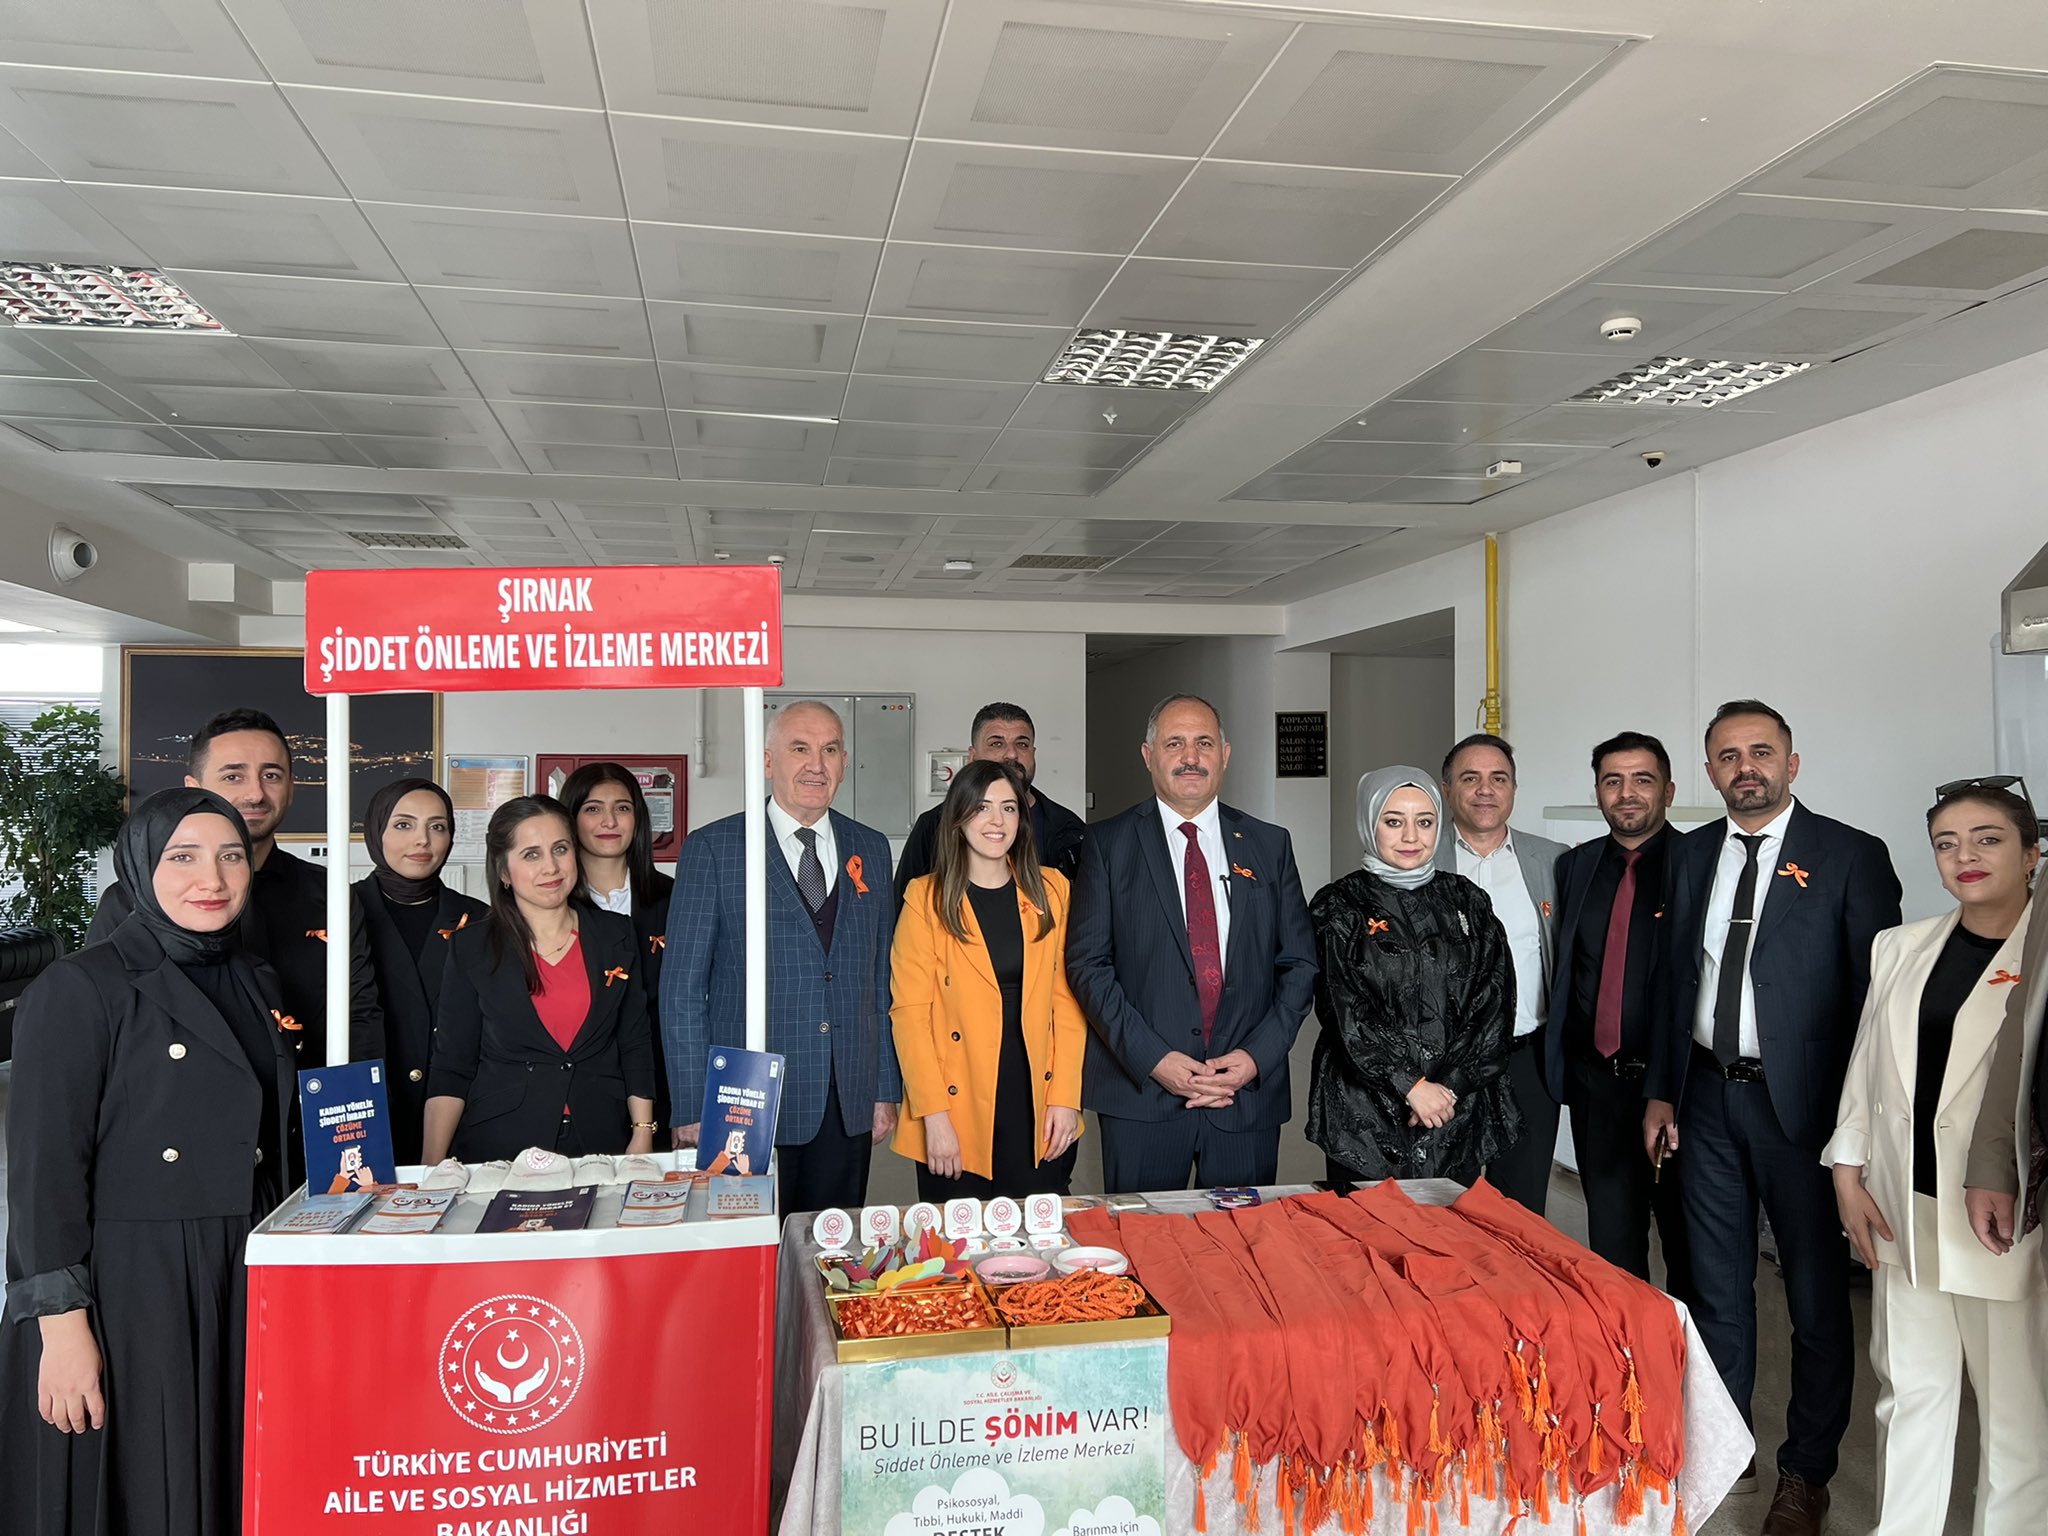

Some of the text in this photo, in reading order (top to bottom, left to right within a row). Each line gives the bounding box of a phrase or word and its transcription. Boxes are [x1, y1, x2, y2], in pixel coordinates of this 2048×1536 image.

[498, 577, 593, 623] ŞIRNAK
[320, 621, 768, 683] ŞİDDET ÖNLEME VE İZLEME MERKEZİ
[1281, 716, 1321, 724] TOPLANTI
[719, 1085, 741, 1096] KADINA
[319, 1099, 373, 1117] KADINA YÖNELİK
[319, 1114, 346, 1128] ŞİDDETİ
[367, 1108, 375, 1118] ET
[336, 1121, 362, 1134] ÇÖZÜME
[333, 1130, 367, 1143] ORTAK OL!
[860, 1406, 1148, 1450] BU İLDE ŞÖNİM VAR!
[353, 1431, 667, 1477] TÜRKİYE CUMHURİYETİ
[874, 1439, 1135, 1478] Şiddet Önleme ve İzleme Merkezi
[324, 1466, 697, 1514] AİLE VE SOSYAL HİZMETLER
[937, 1495, 1000, 1510] Psikososyal,
[437, 1509, 588, 1536] BAKANLIĞI
[914, 1508, 1023, 1527] Tıbbi, Hukuki, Maddi
[1073, 1521, 1139, 1536] Barınma için
